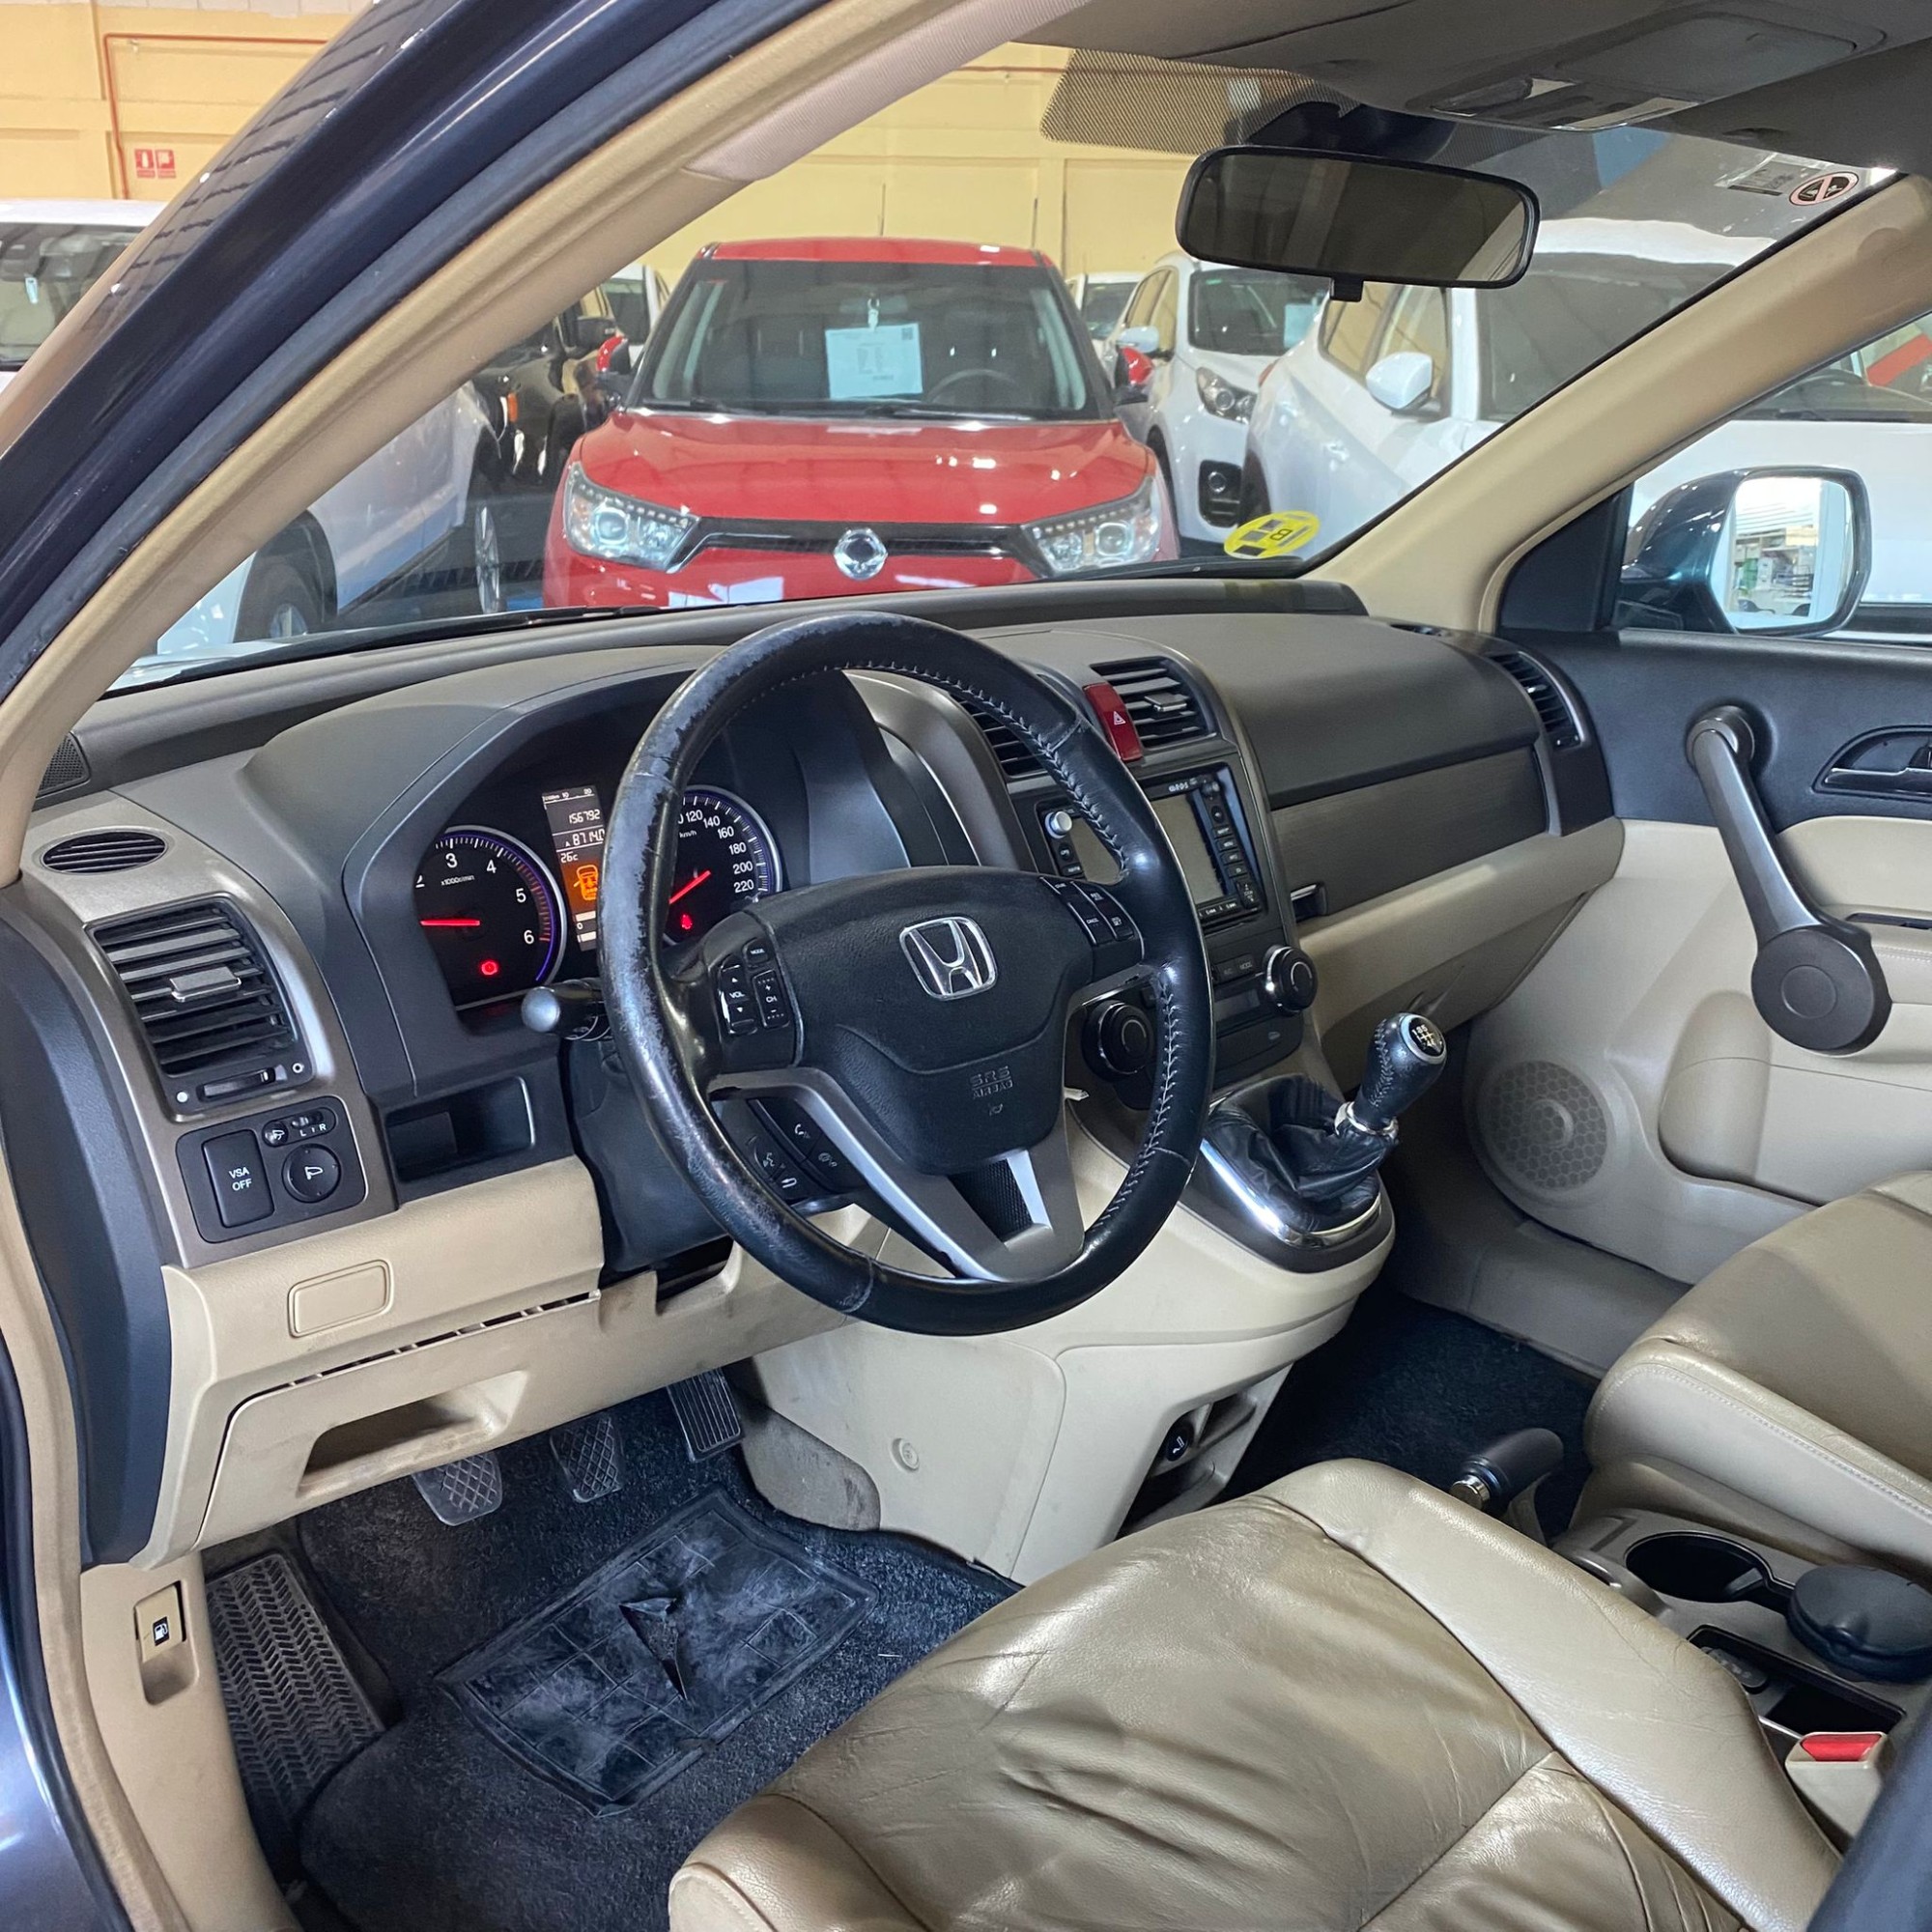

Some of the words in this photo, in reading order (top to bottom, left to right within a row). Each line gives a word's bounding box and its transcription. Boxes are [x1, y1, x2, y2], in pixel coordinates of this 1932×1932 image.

[569, 809, 600, 824] 156792
[685, 809, 703, 822] 120
[703, 815, 721, 829] 140
[717, 826, 734, 839] 160
[728, 841, 747, 855] 180
[445, 853, 458, 868] 3
[486, 859, 497, 874] 4
[732, 861, 753, 875] 200
[733, 879, 754, 894] 220
[515, 887, 526, 903] 5
[524, 929, 535, 945] 6
[228, 1167, 250, 1179] VSA
[232, 1178, 252, 1191] OFF
